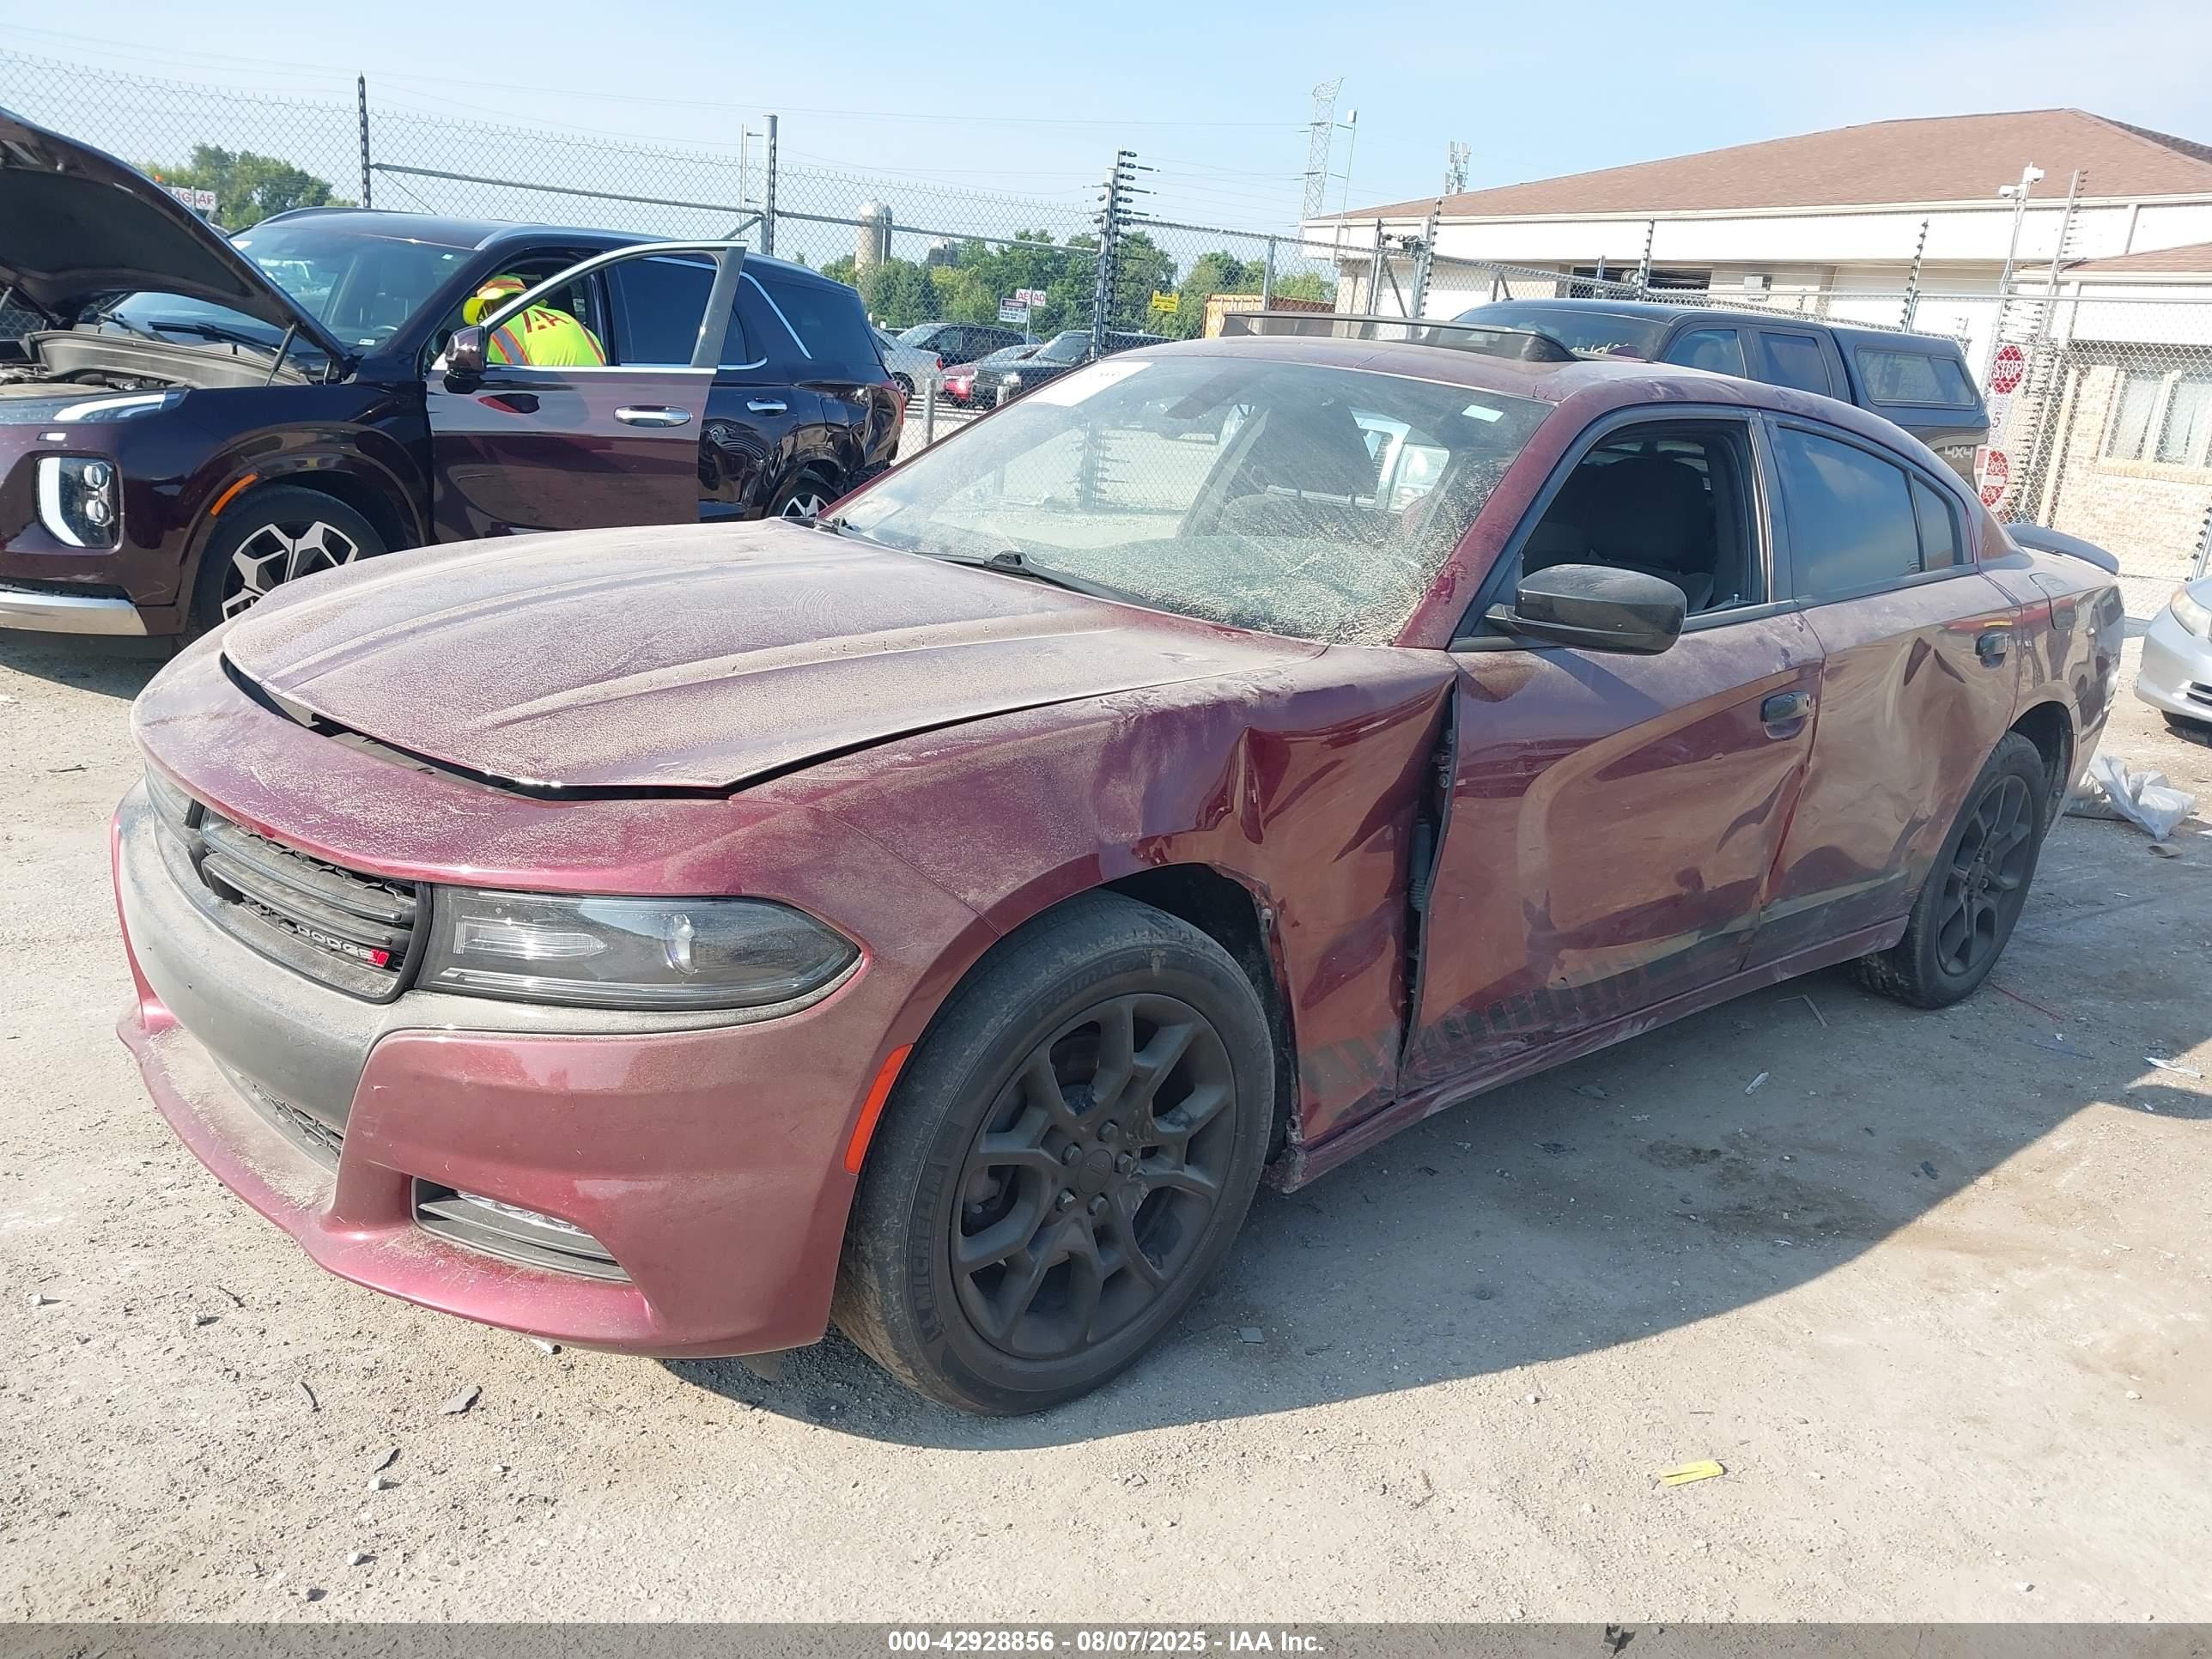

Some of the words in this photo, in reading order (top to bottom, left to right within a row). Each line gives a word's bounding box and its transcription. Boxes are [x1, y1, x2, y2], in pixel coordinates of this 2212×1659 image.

[1033, 294, 1045, 302] AD
[1992, 361, 2022, 379] STOP
[1944, 446, 1973, 459] 4X4
[296, 924, 376, 962] DODGE
[913, 1166, 943, 1312] MICHELIN
